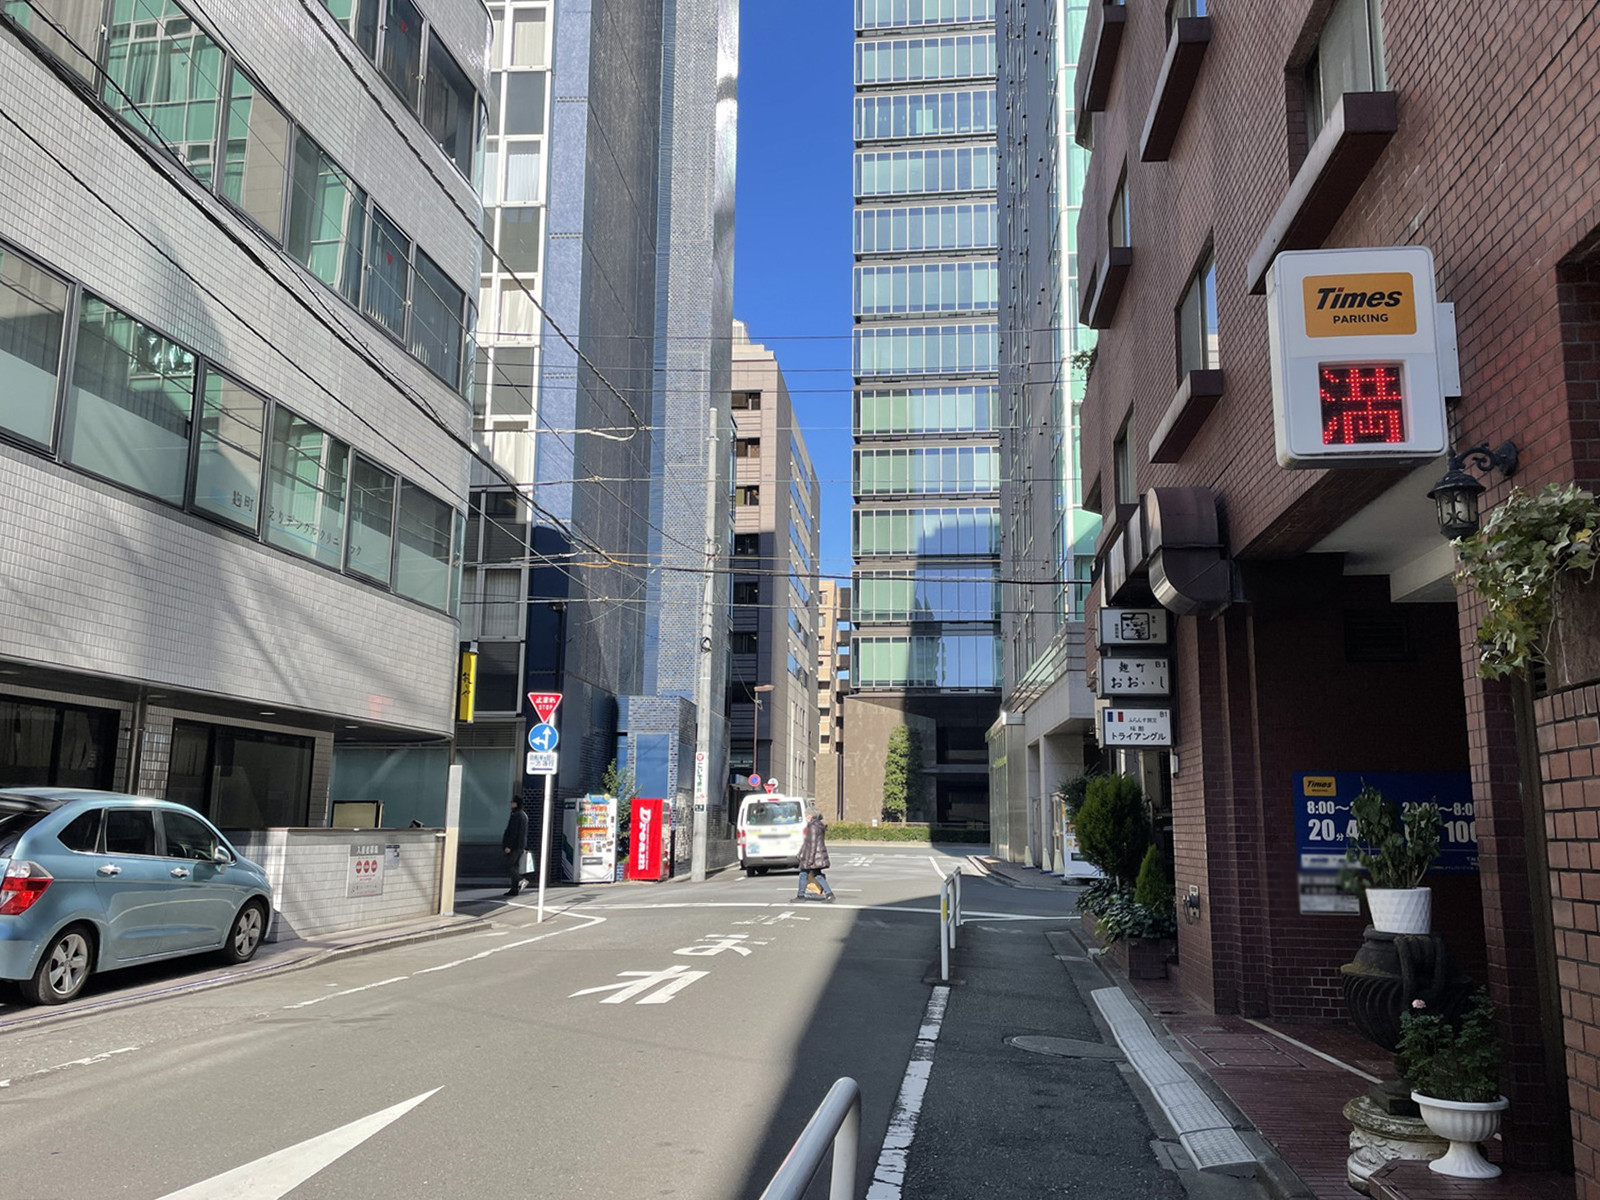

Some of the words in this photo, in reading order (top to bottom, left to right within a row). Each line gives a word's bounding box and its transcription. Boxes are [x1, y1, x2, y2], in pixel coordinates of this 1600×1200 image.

[1316, 287, 1403, 310] Times
[1332, 313, 1389, 324] PARKING
[1155, 661, 1166, 669] B1
[1111, 732, 1166, 741] トライアングル
[1307, 780, 1333, 788] Times
